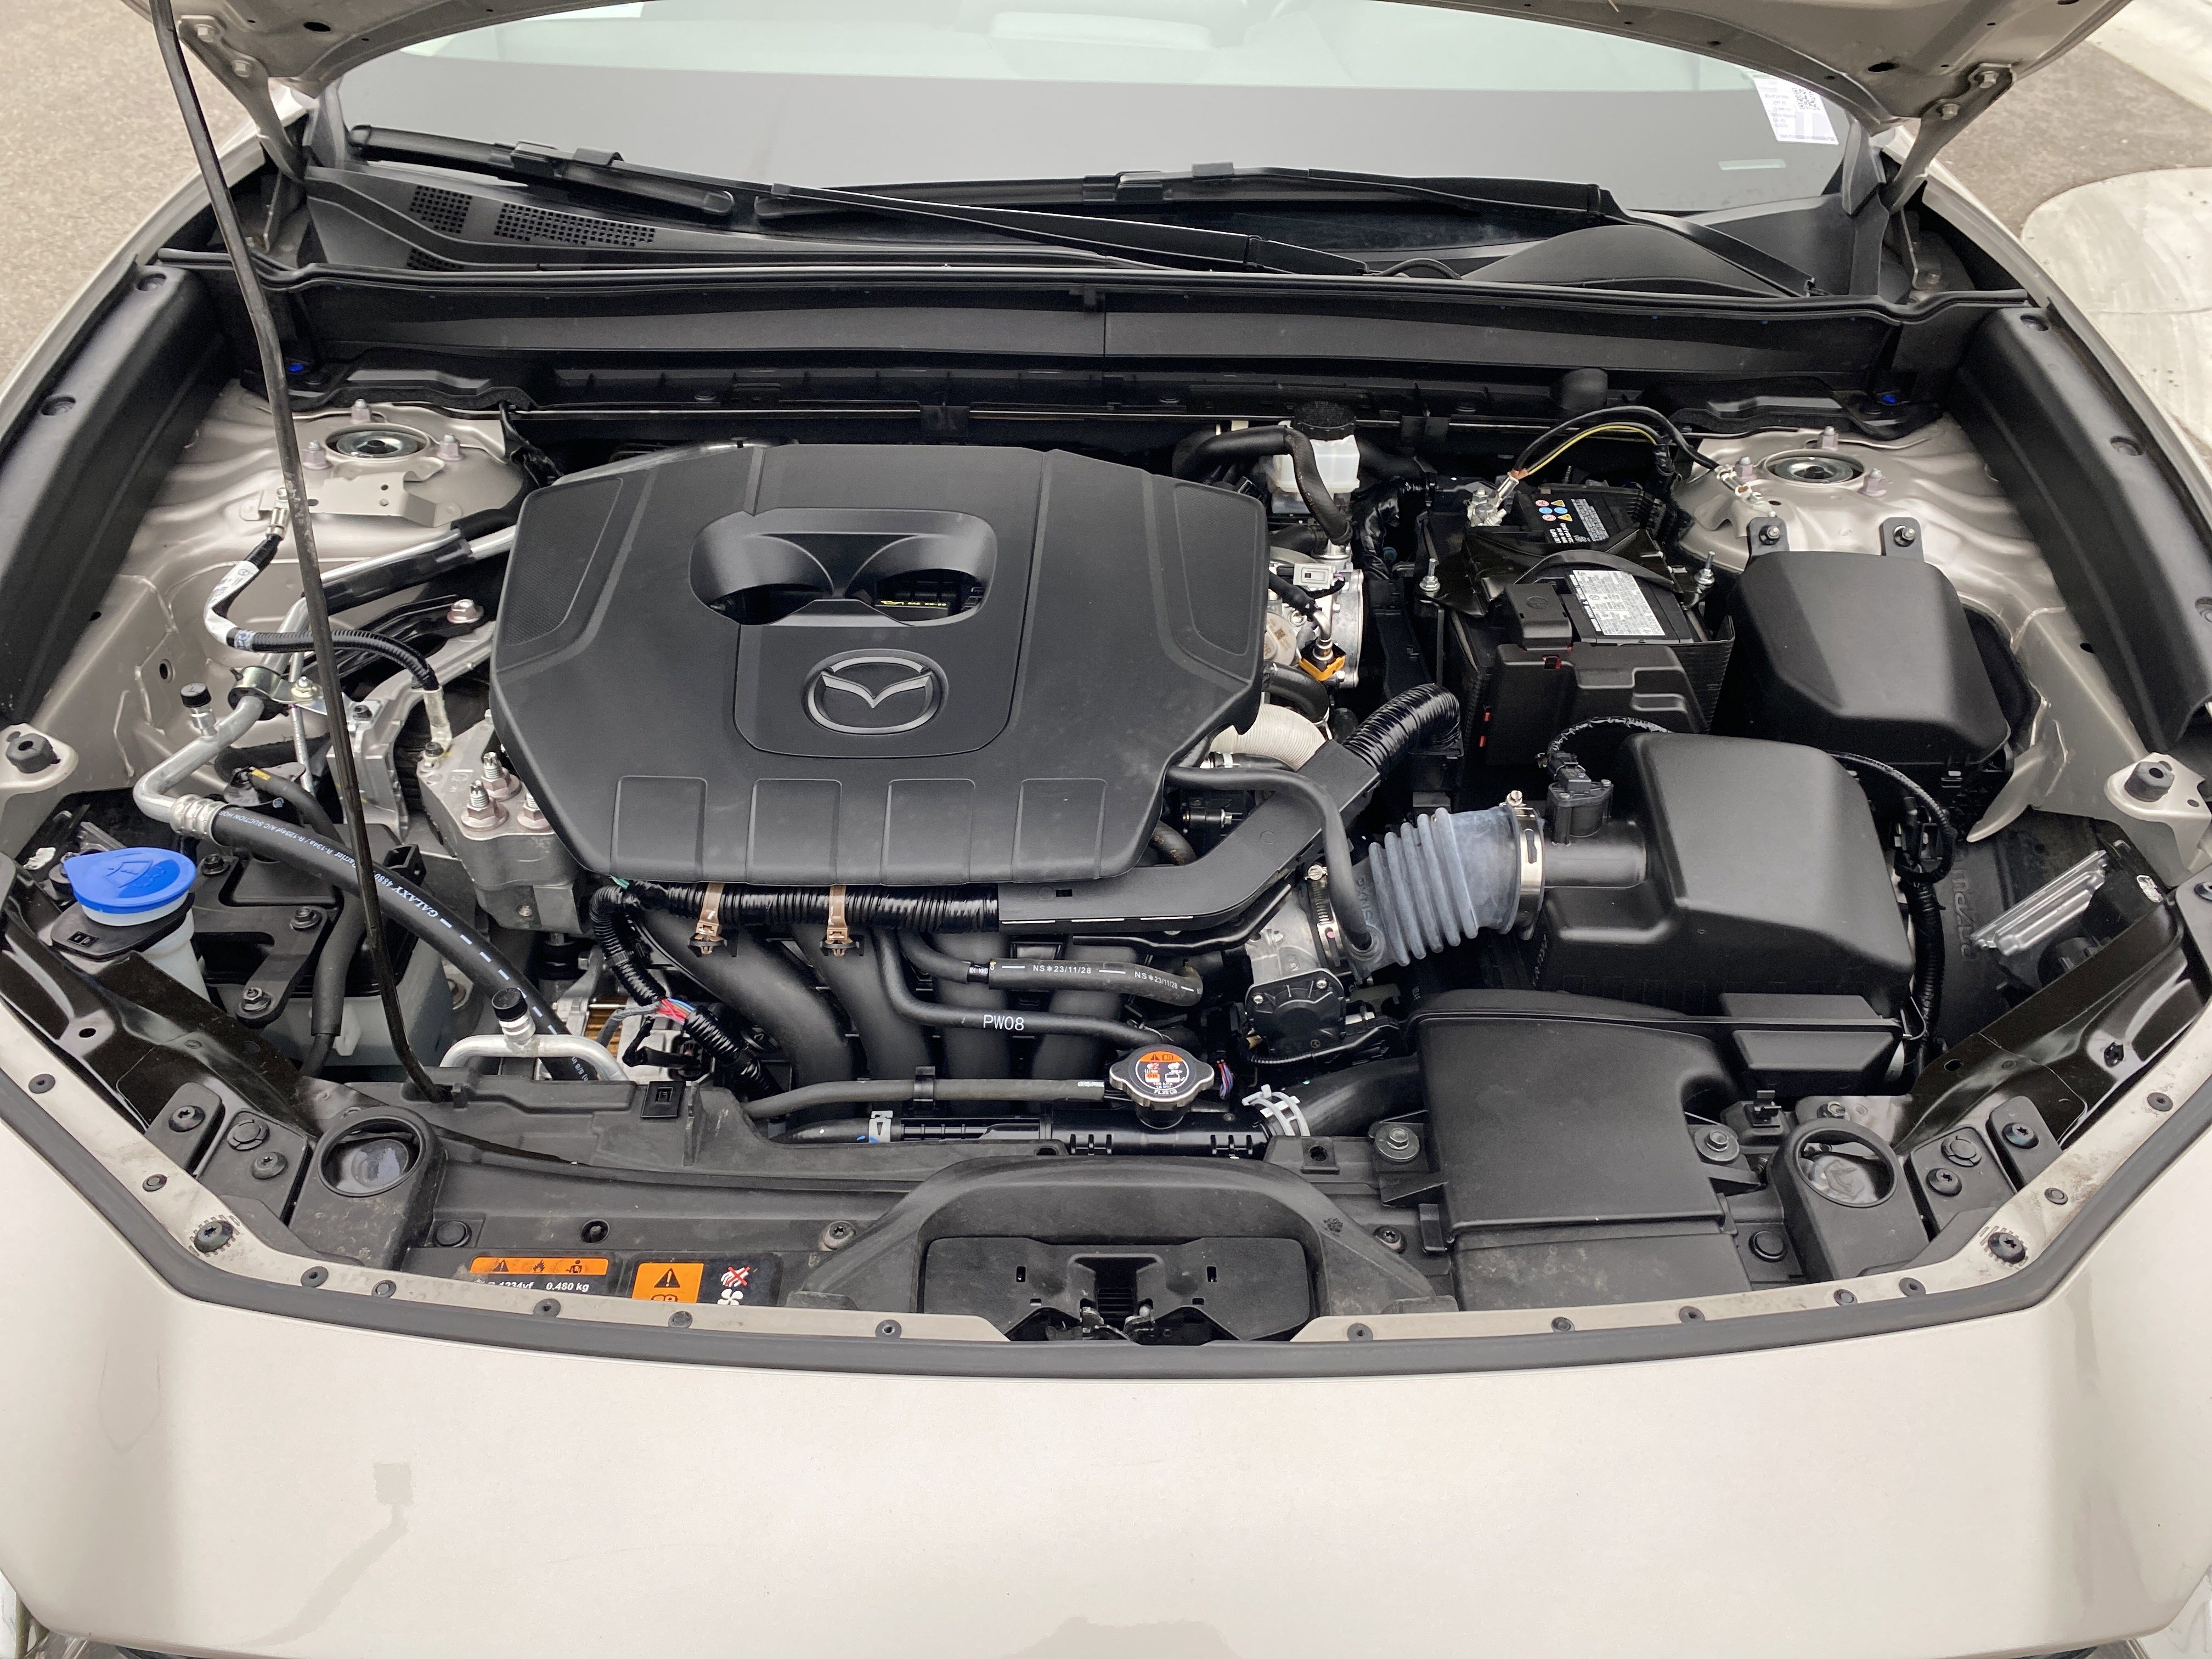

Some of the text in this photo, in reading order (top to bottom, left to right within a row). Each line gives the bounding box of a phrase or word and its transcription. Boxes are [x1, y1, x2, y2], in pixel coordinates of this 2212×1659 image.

[219, 810, 235, 818] HOS
[234, 813, 265, 827] SUCTION
[263, 823, 276, 832] A/C
[309, 839, 334, 854] R-134a
[374, 873, 393, 887] 4880
[391, 885, 438, 917] GALAXY
[983, 1014, 1024, 1031] PW08
[575, 1282, 590, 1293] kg
